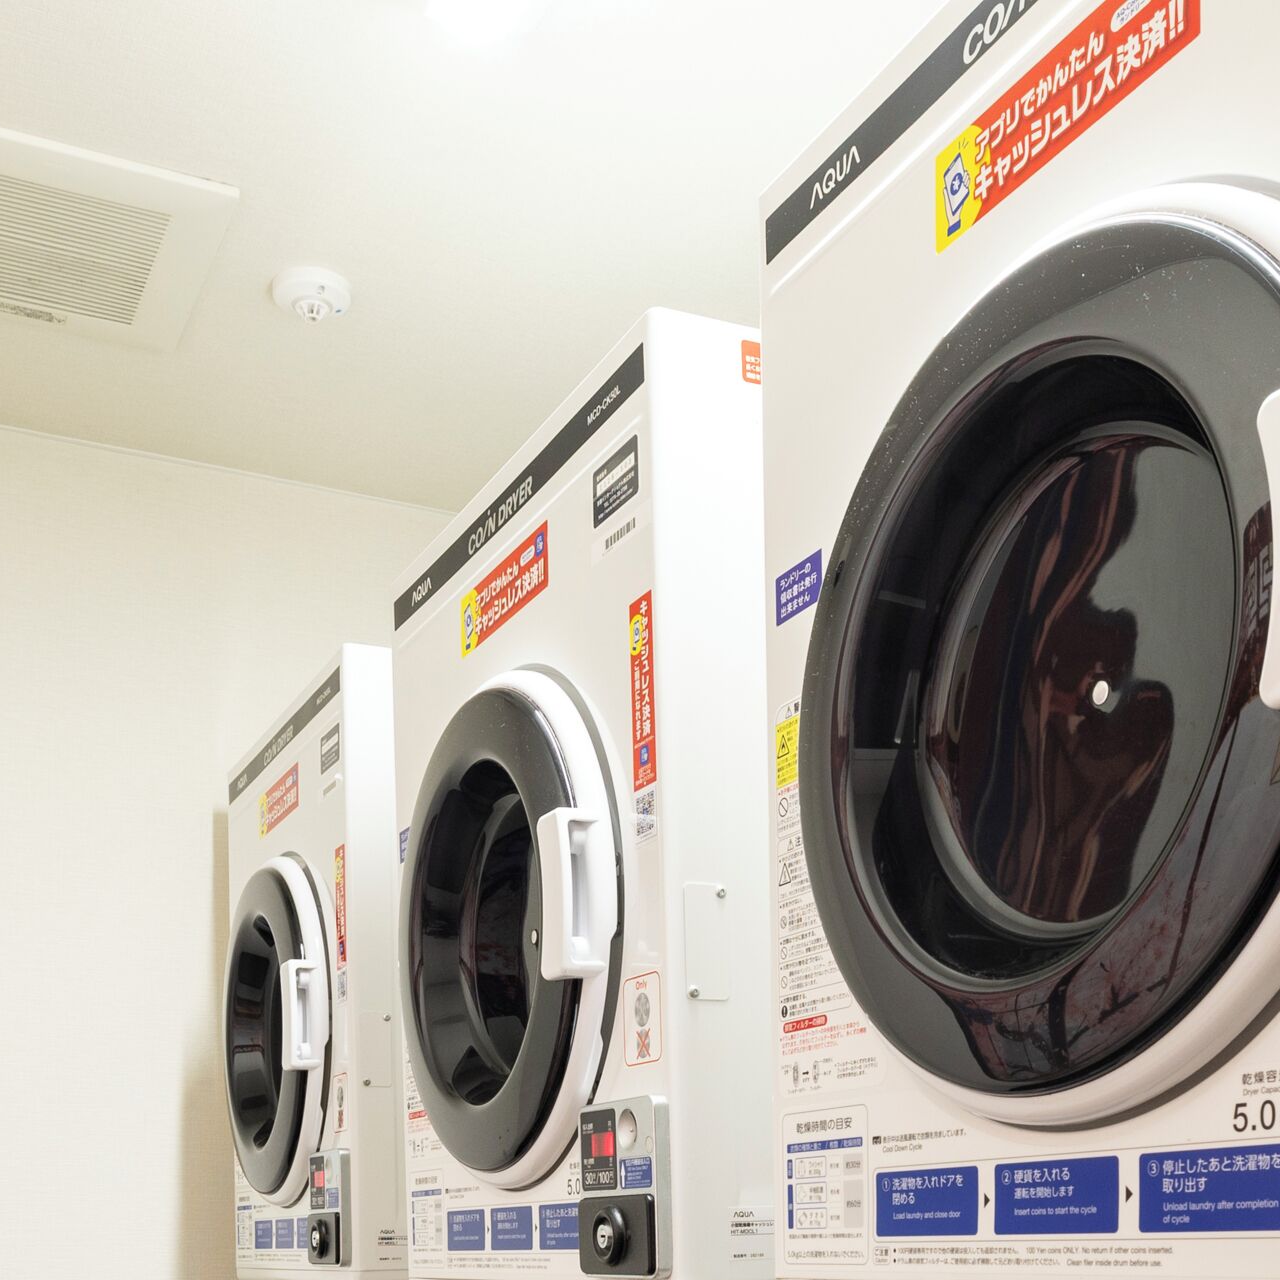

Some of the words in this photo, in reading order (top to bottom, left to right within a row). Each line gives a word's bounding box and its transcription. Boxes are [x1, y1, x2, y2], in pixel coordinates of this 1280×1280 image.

[974, 0, 1184, 200] キャッシュレス決済!!
[975, 33, 1104, 161] アプリでかんたん
[810, 145, 861, 209] AQUA
[498, 475, 534, 526] DRYER
[780, 562, 811, 591] ランドリーの
[412, 578, 432, 606] AQUA
[475, 561, 519, 611] アプリでかんたん
[780, 572, 817, 604] 領収書は発行
[475, 557, 544, 635] キャッシュレス決済!!
[780, 592, 810, 618] 出来ません
[635, 979, 648, 991] Only
[1243, 1086, 1263, 1096] Dryer
[796, 1117, 852, 1134] 乾燥時間の目安
[892, 1174, 964, 1192] 洗濯物を入れドアを
[1014, 1168, 1070, 1184] 硬貨を入れる
[1014, 1185, 1074, 1200] 運転を開始します
[1162, 1177, 1208, 1194] 取り出す
[892, 1192, 916, 1206] 閉める
[1163, 1202, 1188, 1212] Unload
[1189, 1200, 1215, 1213] laundry
[1217, 1200, 1234, 1210] after
[1235, 1198, 1279, 1211] completion
[934, 1210, 948, 1219] close
[948, 1210, 961, 1219] door
[1014, 1207, 1030, 1216] Insert
[1031, 1207, 1047, 1215] coins
[1055, 1206, 1069, 1215] start
[1070, 1206, 1080, 1214] the
[1080, 1205, 1097, 1216] cycle
[1163, 1215, 1170, 1224] of
[1171, 1215, 1190, 1226] cycle
